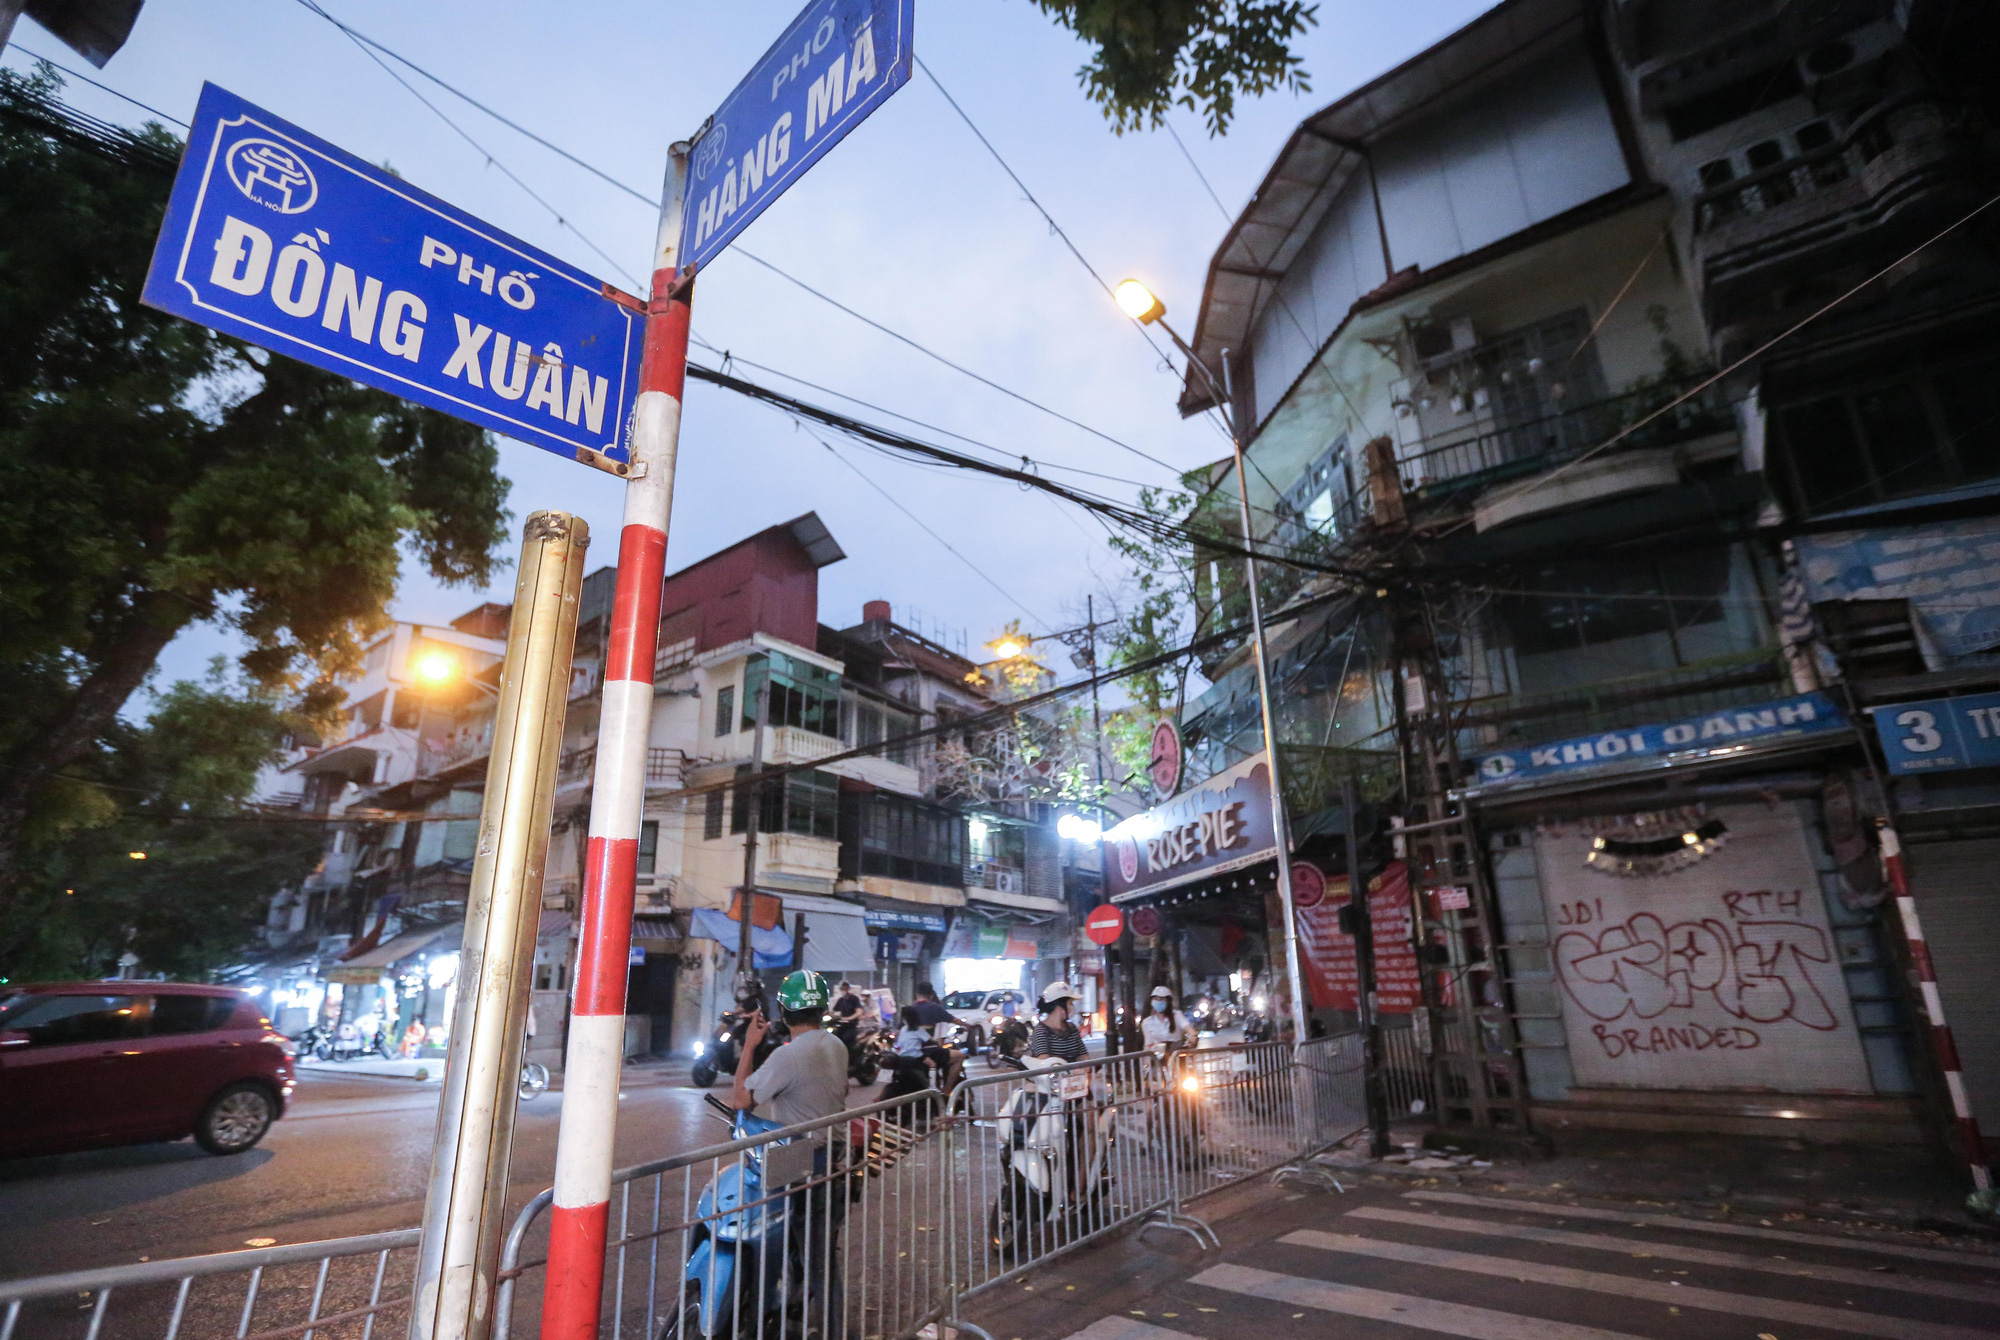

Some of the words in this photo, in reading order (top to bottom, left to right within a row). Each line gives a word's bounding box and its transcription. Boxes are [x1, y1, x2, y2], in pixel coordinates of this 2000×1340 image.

[694, 111, 792, 251] HÀNG
[804, 14, 878, 142] MÃ
[250, 194, 263, 205] HÀ
[264, 201, 282, 213] NỘI
[419, 234, 541, 311] PHỐ
[209, 214, 427, 363] ĐỒNG
[442, 312, 609, 435] XUÂN
[1662, 702, 1816, 746] OANH
[1896, 710, 1942, 752] 3
[1147, 822, 1196, 874] ROSE
[1199, 802, 1237, 857] PIE
[1722, 890, 1801, 918] RTH
[801, 990, 822, 1001] Grab
[1591, 1022, 1761, 1059] BRANDED
